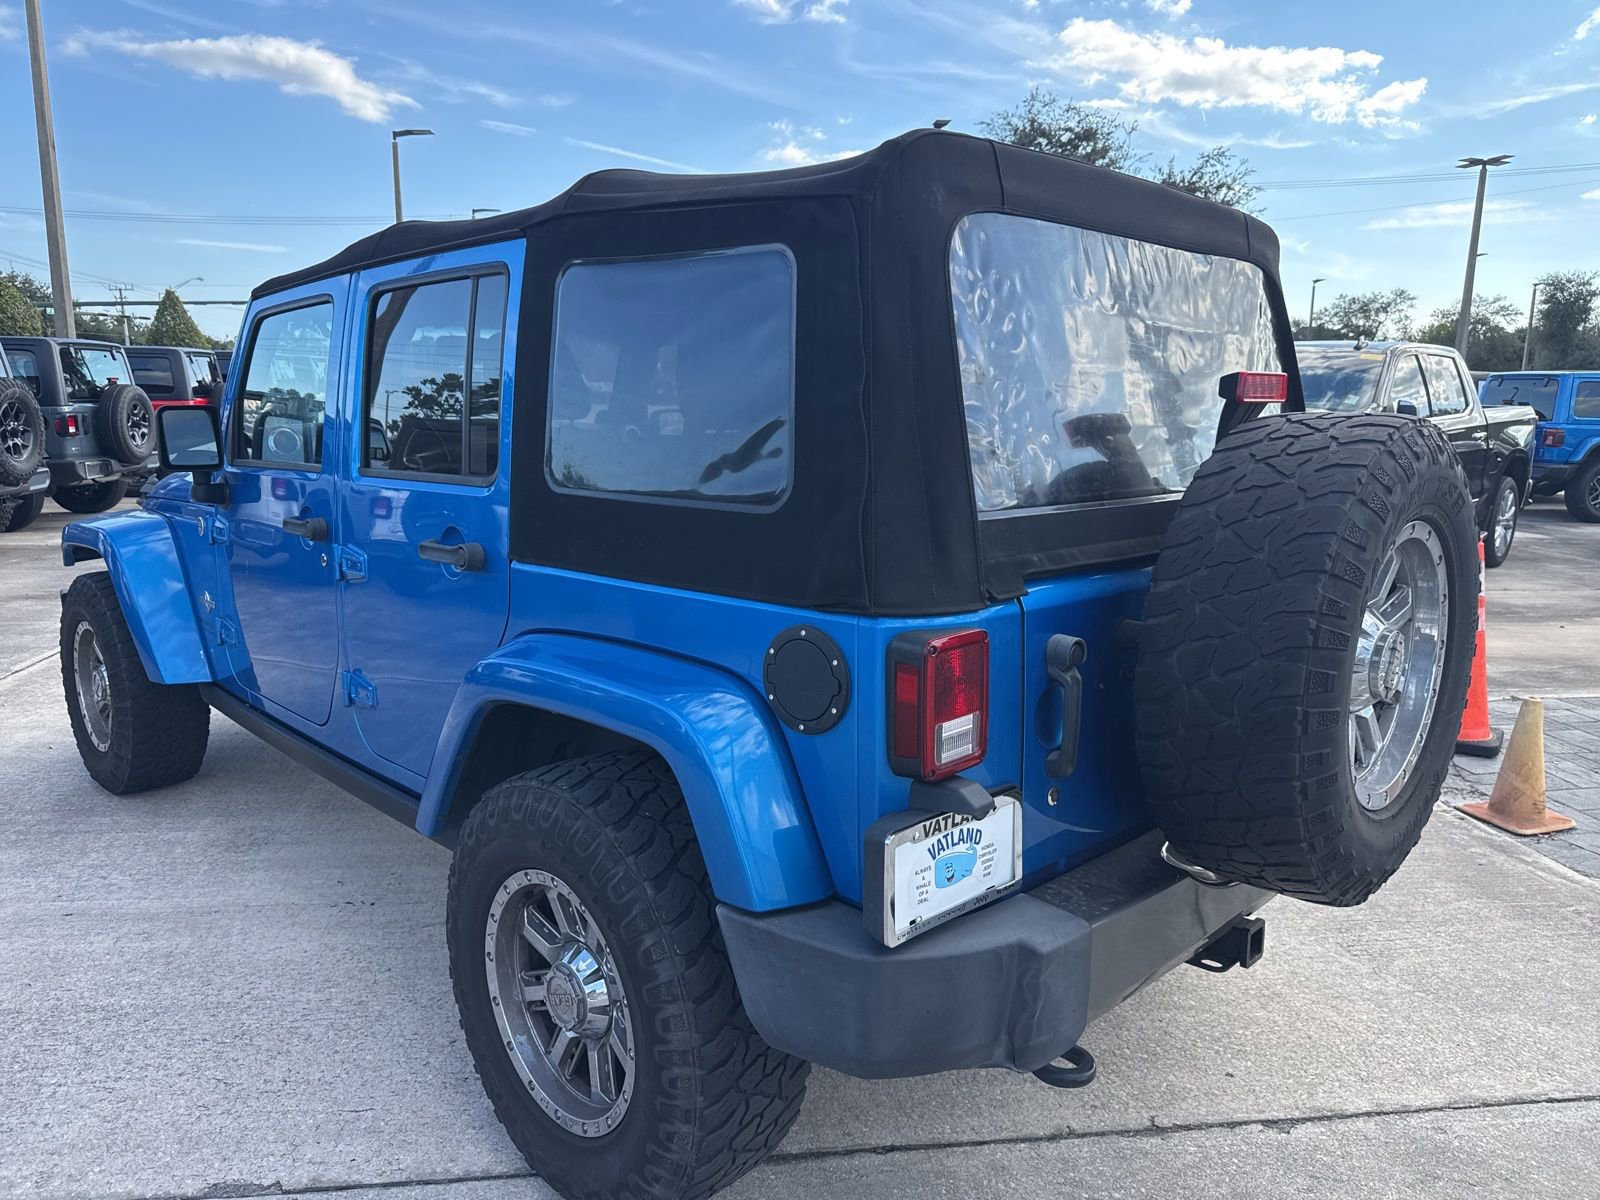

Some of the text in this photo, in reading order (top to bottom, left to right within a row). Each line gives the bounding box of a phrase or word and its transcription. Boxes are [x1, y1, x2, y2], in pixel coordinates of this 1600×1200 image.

[923, 812, 974, 839] VATLA
[927, 827, 982, 861] VATLAND
[914, 865, 932, 875] ALWAYS
[916, 880, 931, 890] WHALE
